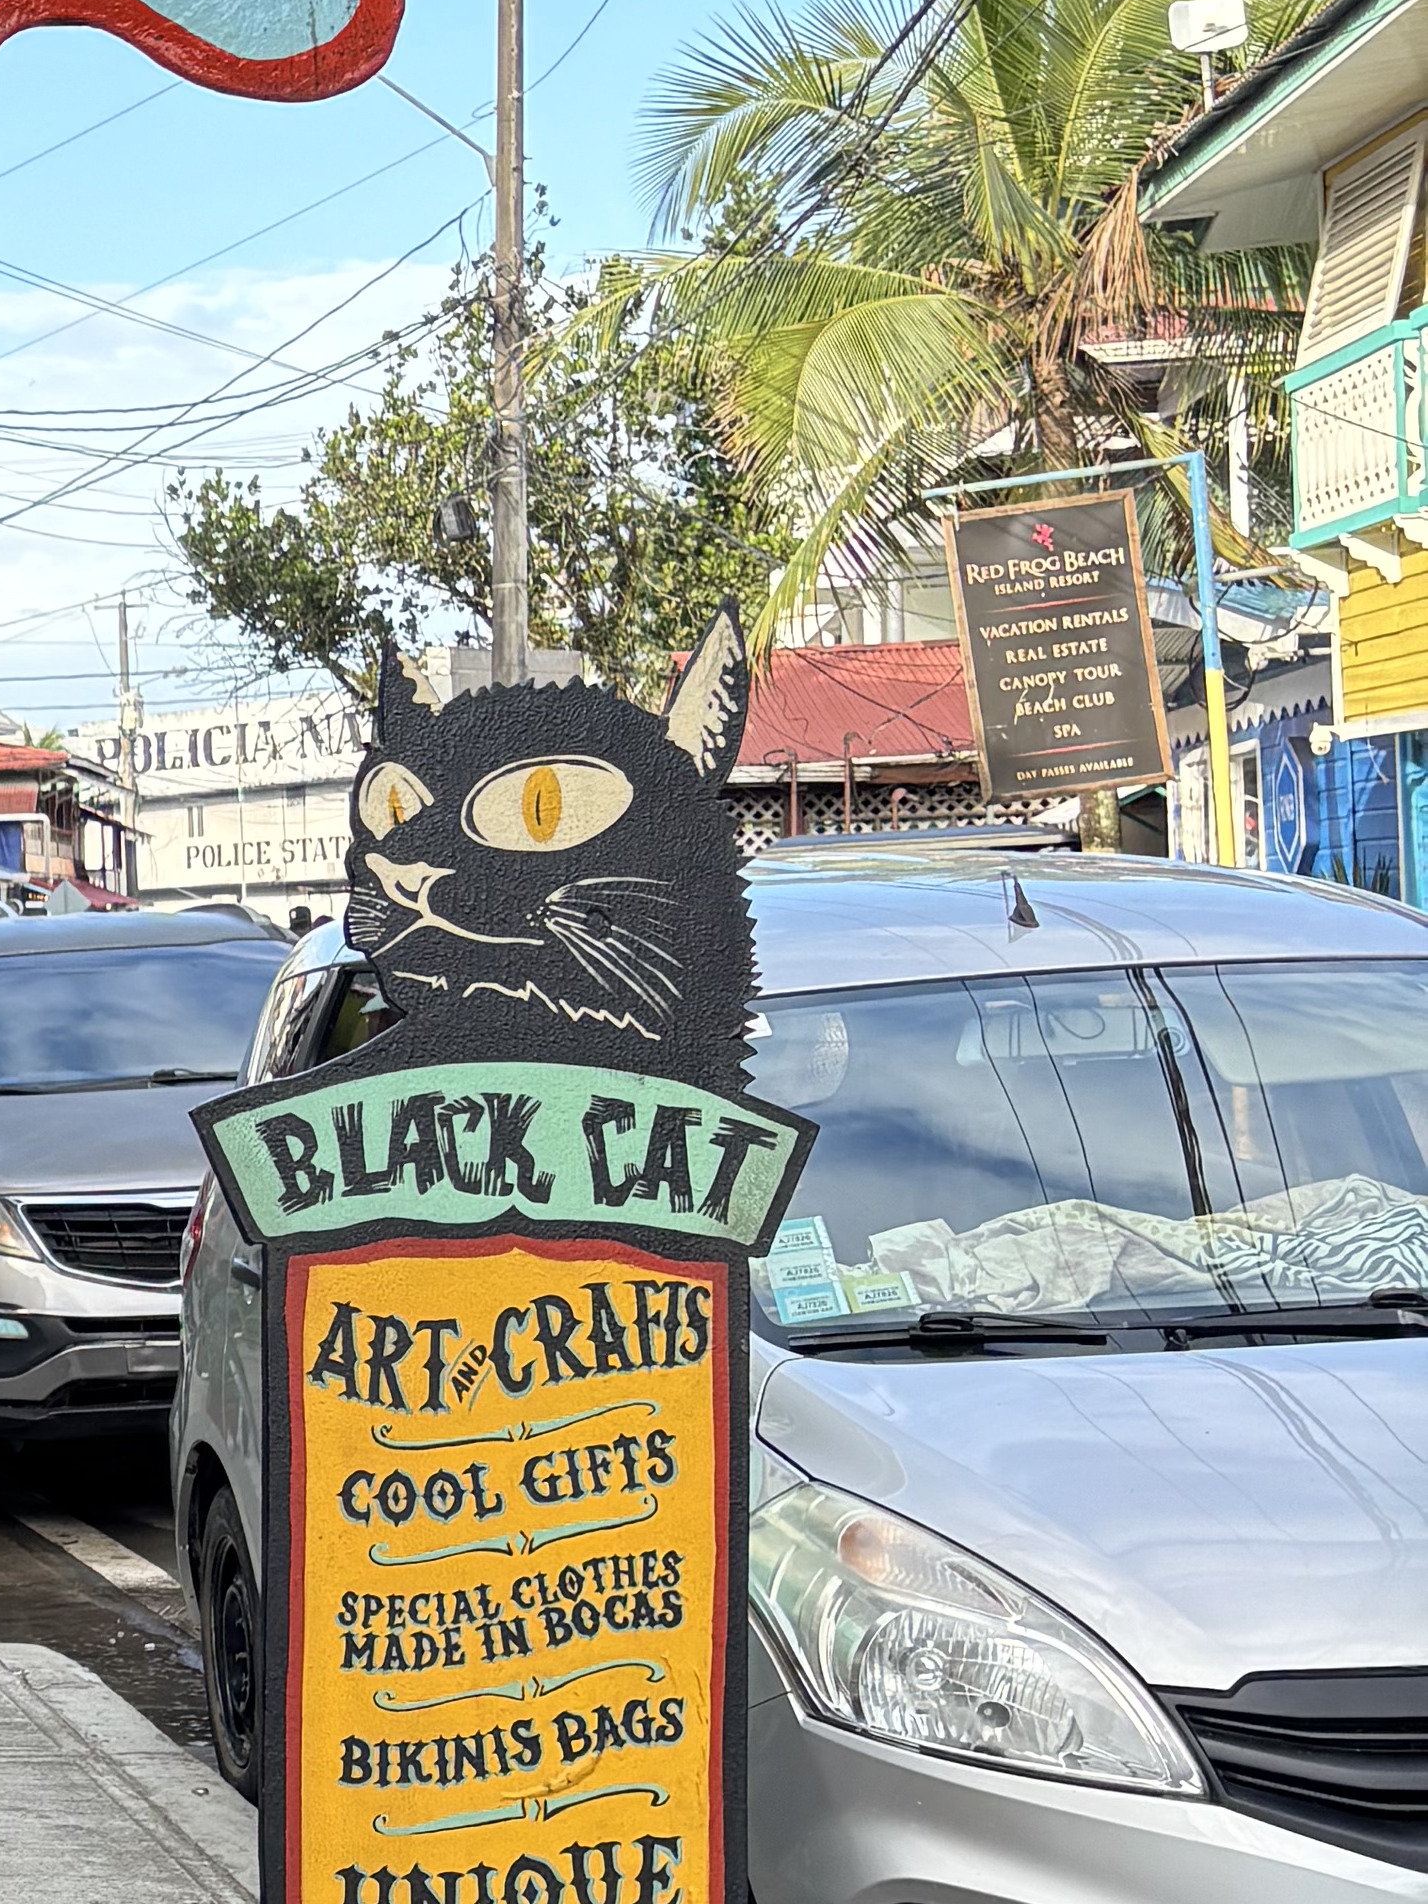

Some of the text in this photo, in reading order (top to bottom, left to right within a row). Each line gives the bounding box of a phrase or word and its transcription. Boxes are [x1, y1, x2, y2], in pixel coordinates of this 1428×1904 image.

[966, 547, 1126, 584] RED FROG BEACH
[995, 571, 1100, 595] ISLAND RESORT
[980, 608, 1129, 640] VACATION RENTALS
[1006, 638, 1107, 664] REAL ESTATE
[999, 664, 1122, 691] CANOPY TOUR
[1015, 691, 1115, 716] BEACH CLUB
[95, 720, 283, 775] POLICIA
[1053, 723, 1081, 738] SPA
[1016, 757, 1134, 781] DAY PASSES AVAILABLE
[187, 835, 352, 869] POLICE STAT
[255, 1090, 778, 1225] BLACK CAT
[306, 1280, 711, 1414] ART AND CRAFTS
[337, 1428, 677, 1526] COOL GIFTS
[336, 1549, 685, 1630] SPECIAL CLOTHES
[339, 1589, 685, 1673] MADE IN BOCAS
[338, 1697, 687, 1789] BIKINIS BAGS
